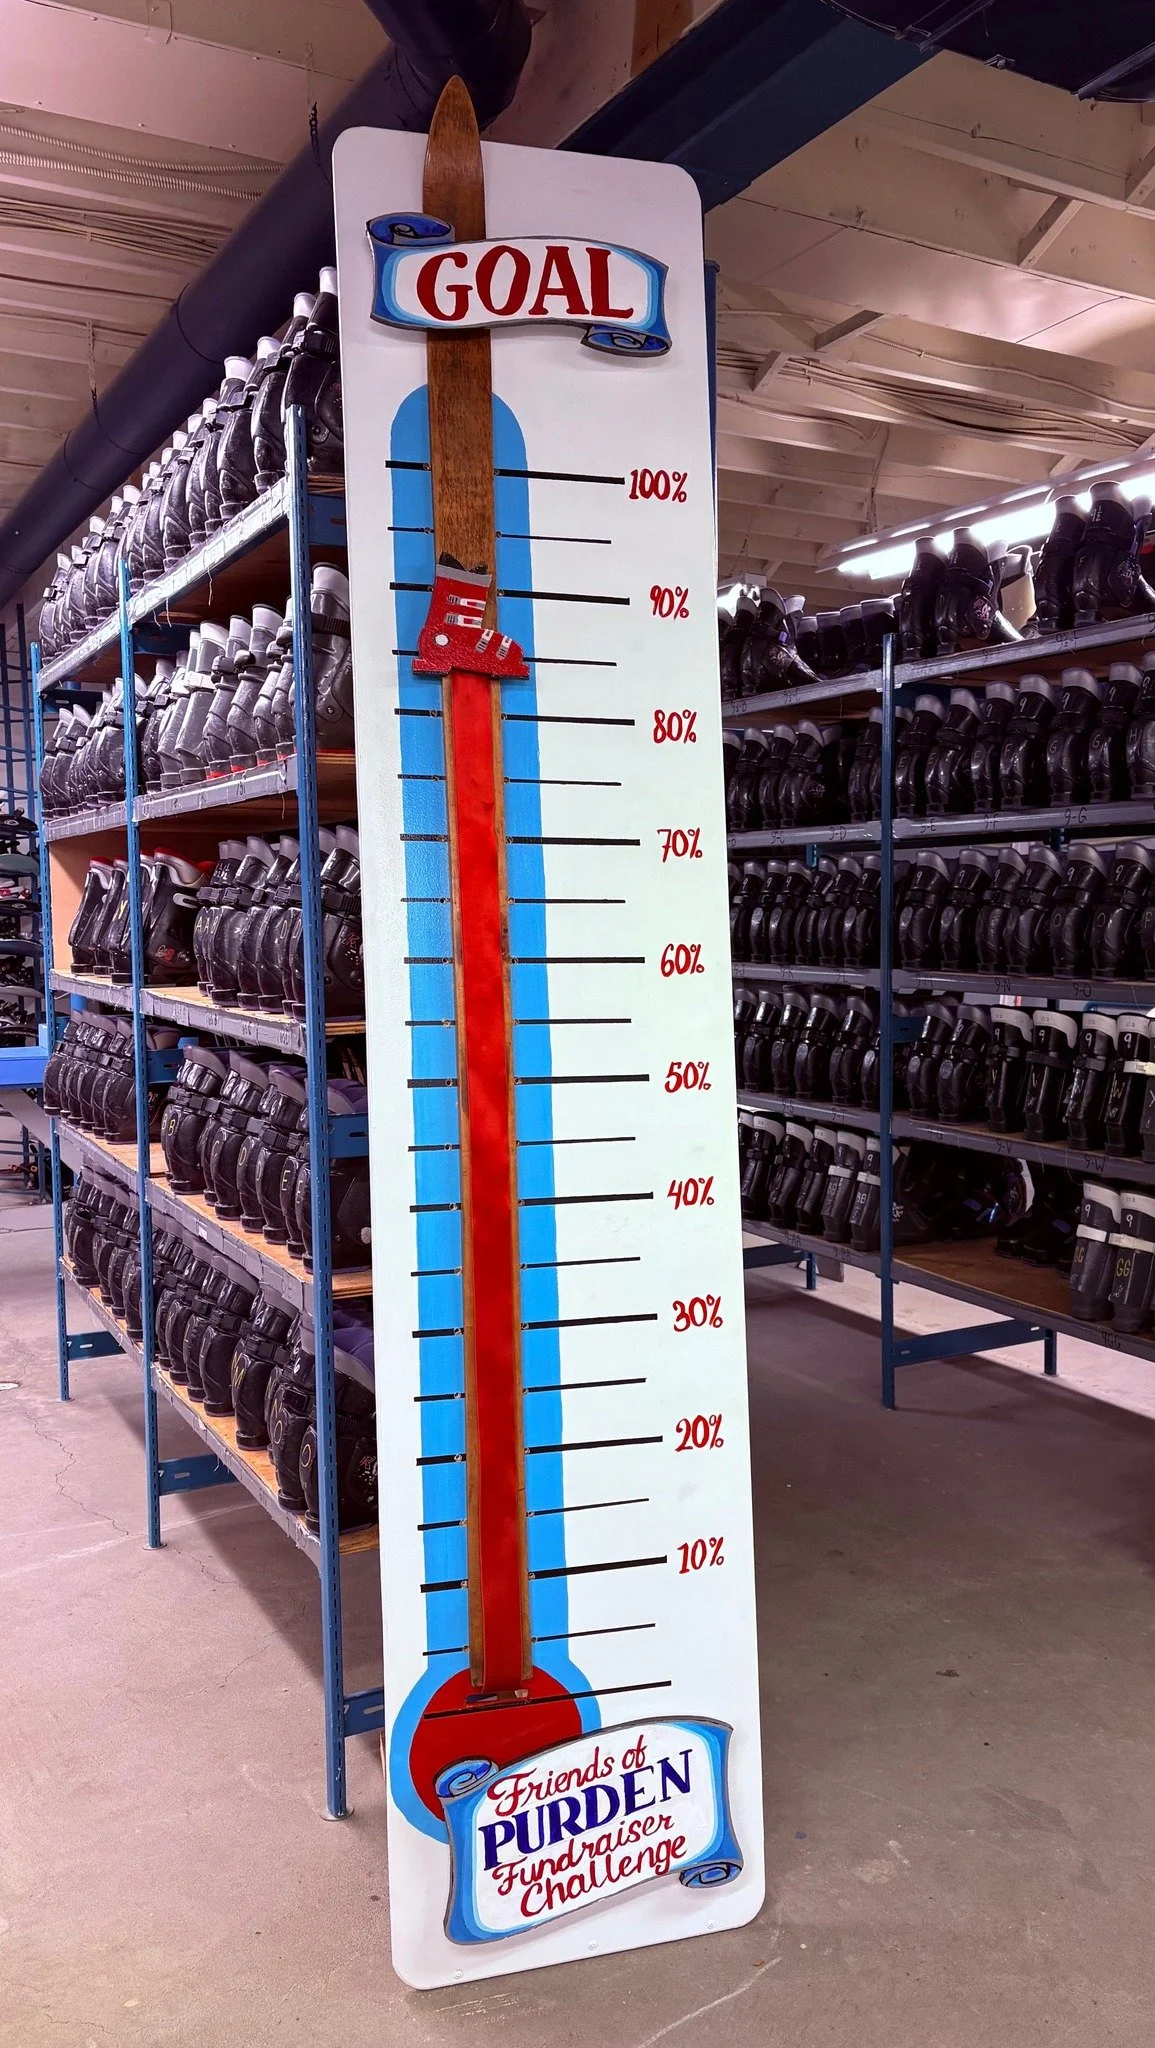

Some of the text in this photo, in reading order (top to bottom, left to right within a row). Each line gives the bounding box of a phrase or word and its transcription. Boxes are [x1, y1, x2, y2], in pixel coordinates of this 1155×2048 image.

[416, 244, 634, 322] GOAL
[629, 468, 688, 503] 100%
[650, 585, 690, 620] 90%
[1061, 692, 1071, 710] 9
[1109, 686, 1117, 702] 9
[1019, 697, 1028, 713] 9
[653, 709, 697, 744] 80%
[1003, 742, 1013, 757] F
[1063, 807, 1087, 826] 9-G
[657, 827, 703, 862] 70%
[861, 872, 869, 885] 9
[916, 870, 923, 885] 9
[959, 869, 966, 884] 9
[1067, 866, 1076, 882] 9
[1115, 864, 1124, 882] 9
[660, 943, 705, 978] 60%
[995, 977, 1011, 992] 9-N
[994, 1027, 1001, 1042] 9
[1084, 1032, 1093, 1049] 9
[1123, 1032, 1133, 1049] 9
[664, 1061, 712, 1093] 50%
[168, 1118, 177, 1137] B
[996, 1139, 1013, 1154] 9-V
[867, 1153, 875, 1167] 9
[1084, 1154, 1106, 1172] 9-W
[282, 1169, 292, 1191] E
[667, 1176, 715, 1210] 40%
[1084, 1203, 1092, 1219] 9
[1125, 1213, 1134, 1228] 9
[255, 1310, 264, 1325] 6
[672, 1294, 723, 1333] 30%
[293, 1357, 302, 1374] 6
[675, 1414, 724, 1452] 20%
[677, 1536, 724, 1574] 10%
[487, 1734, 648, 1817] Friends of
[478, 1749, 693, 1872] PURDEN
[492, 1814, 676, 1896] Fundraiser
[520, 1835, 688, 1918] Challenge
